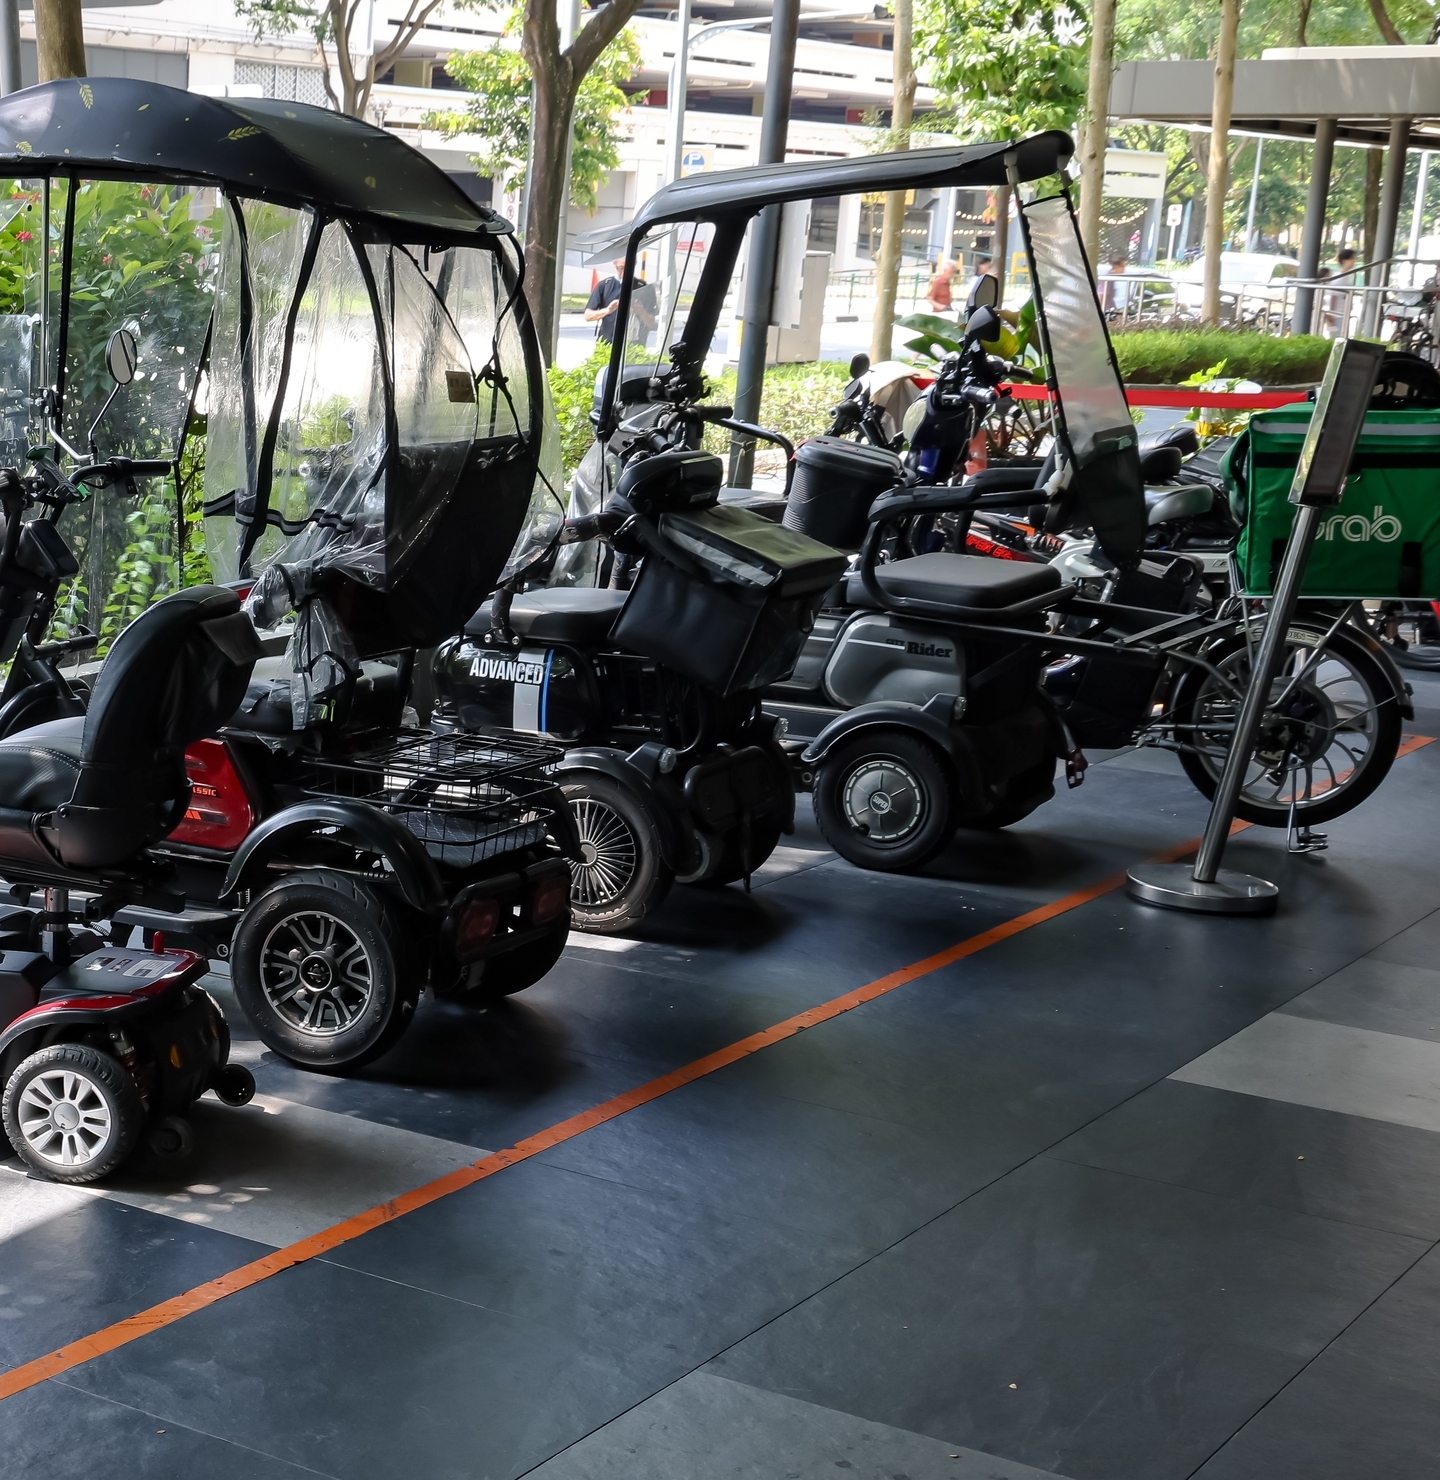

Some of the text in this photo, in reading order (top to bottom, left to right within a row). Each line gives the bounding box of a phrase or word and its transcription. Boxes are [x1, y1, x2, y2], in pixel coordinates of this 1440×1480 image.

[688, 153, 701, 166] P
[1315, 505, 1402, 542] rab
[906, 641, 953, 658] Rider
[469, 657, 544, 685] ADVANCED
